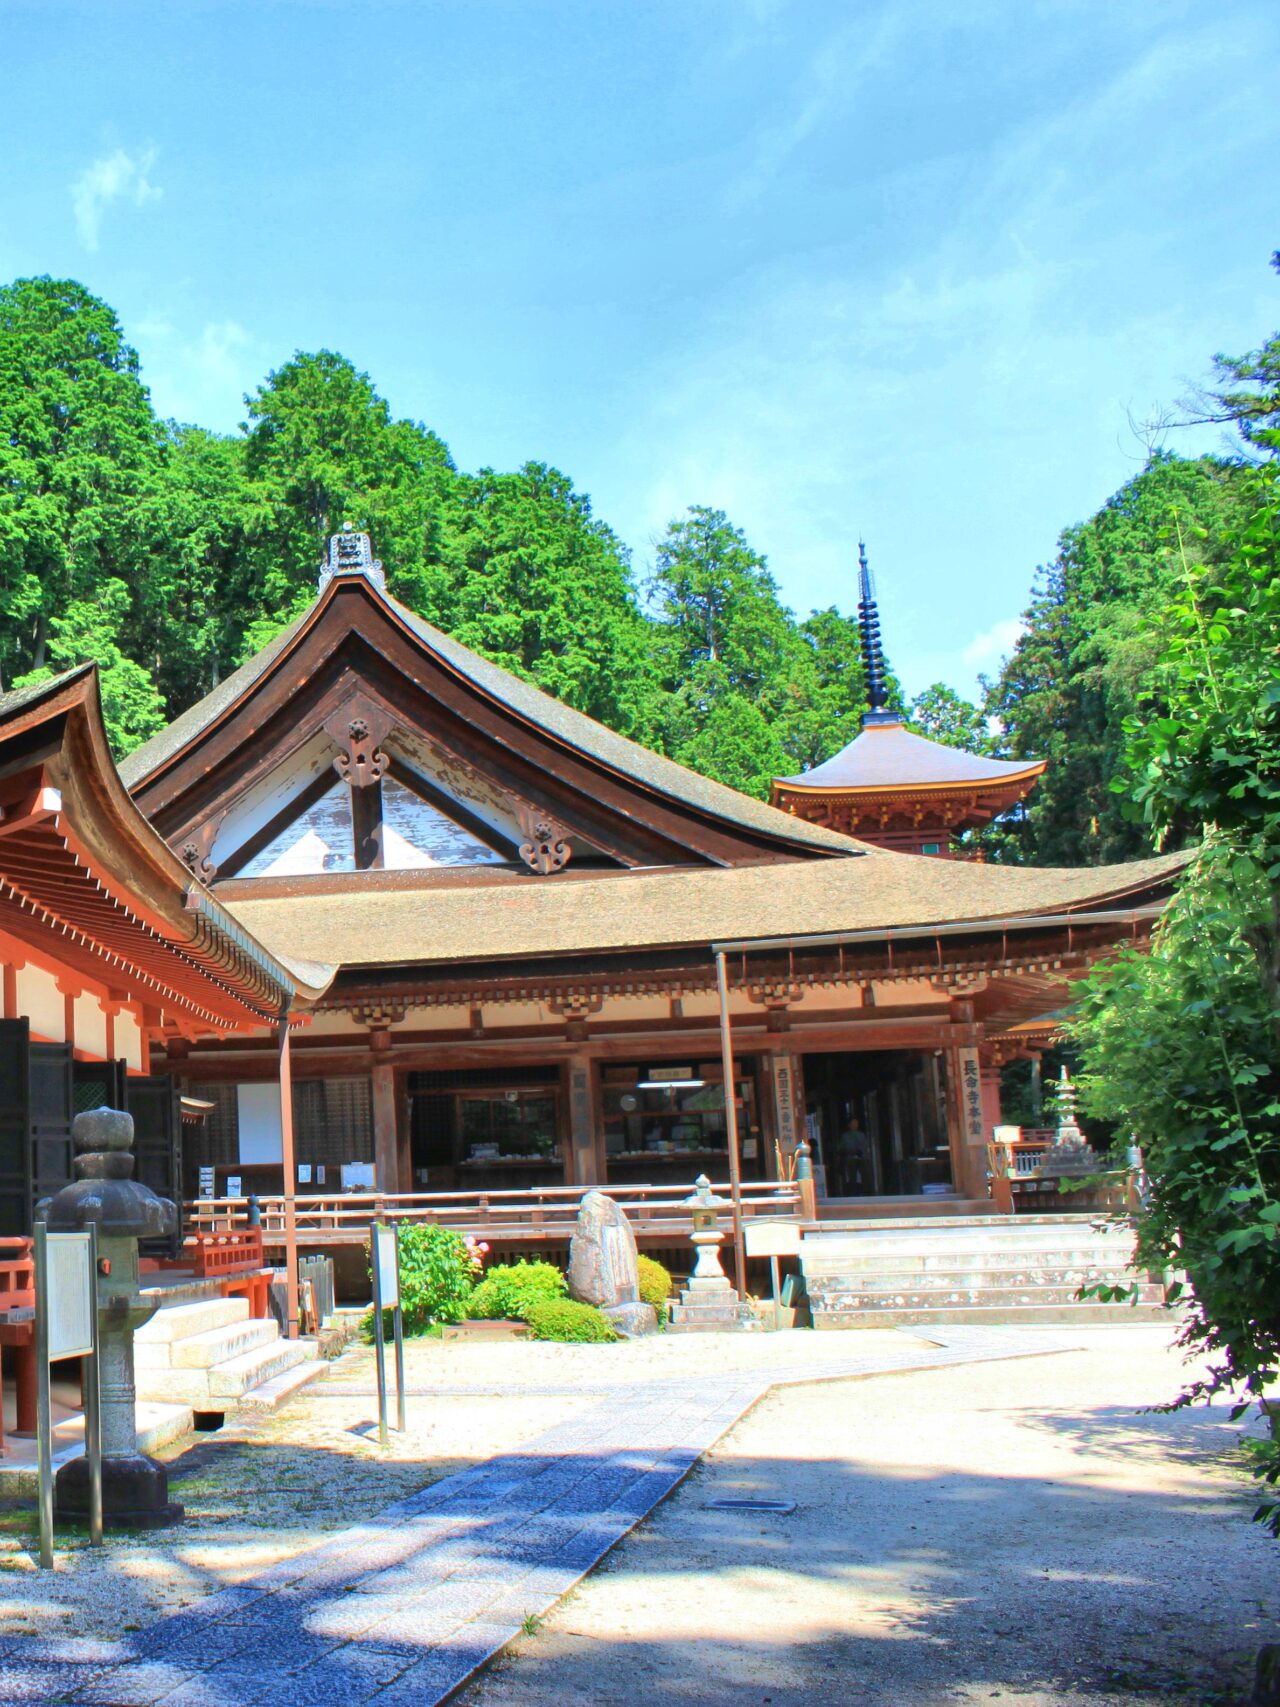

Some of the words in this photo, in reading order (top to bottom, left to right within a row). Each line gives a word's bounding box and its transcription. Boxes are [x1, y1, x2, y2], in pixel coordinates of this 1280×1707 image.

[963, 1060, 982, 1135] 長命寺本堂
